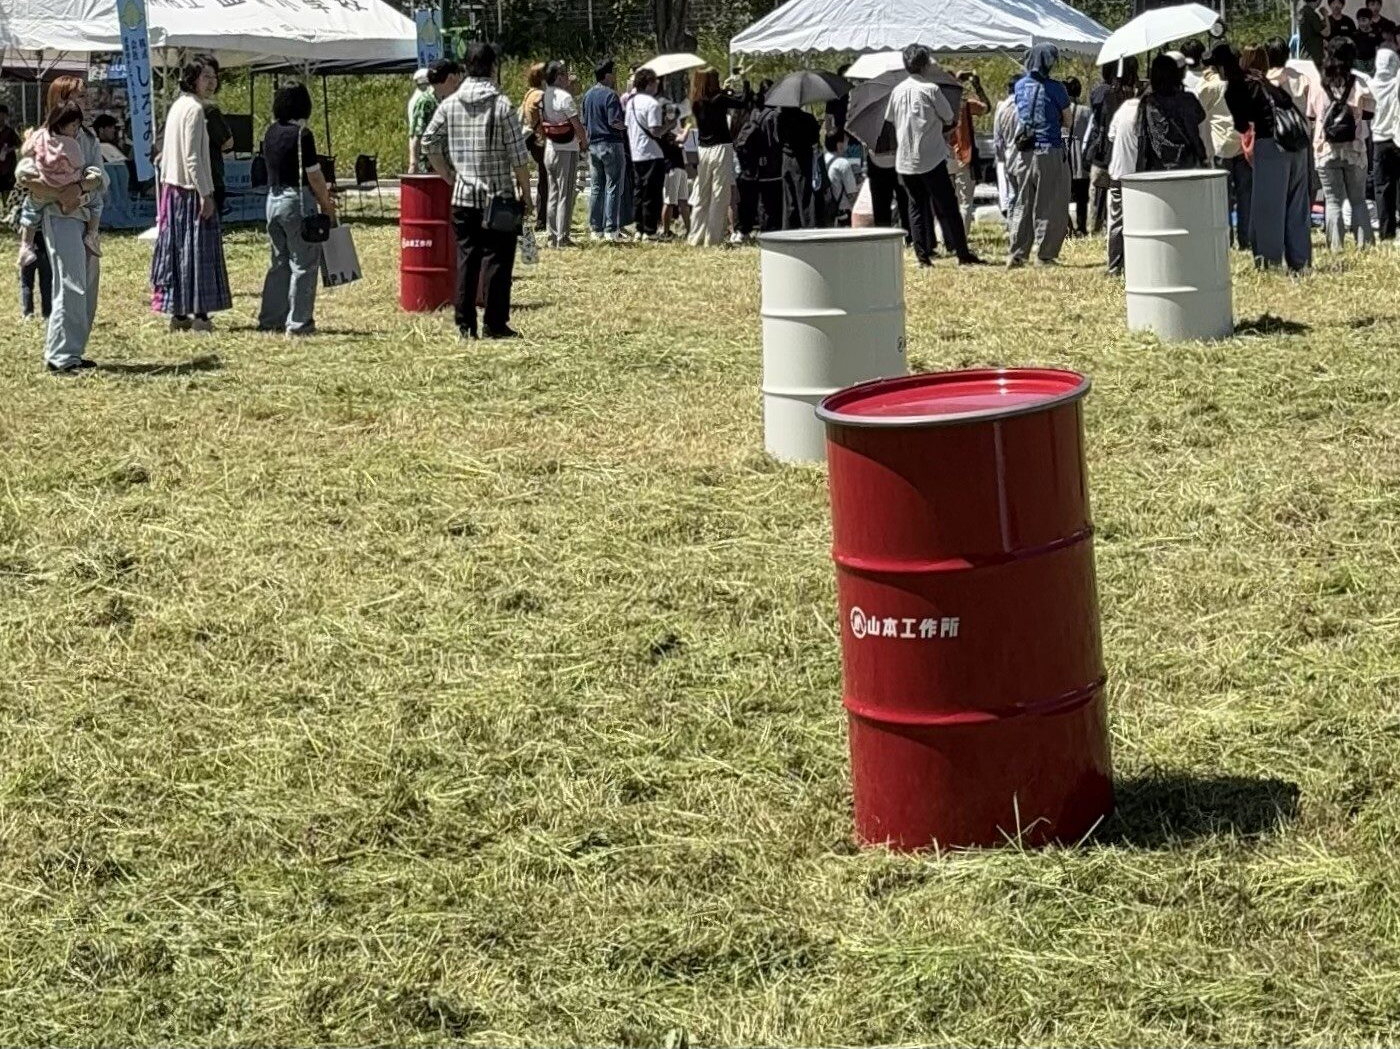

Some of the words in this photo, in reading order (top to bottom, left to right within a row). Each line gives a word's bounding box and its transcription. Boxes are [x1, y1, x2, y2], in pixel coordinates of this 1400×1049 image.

[867, 615, 960, 639] 山本工作所
